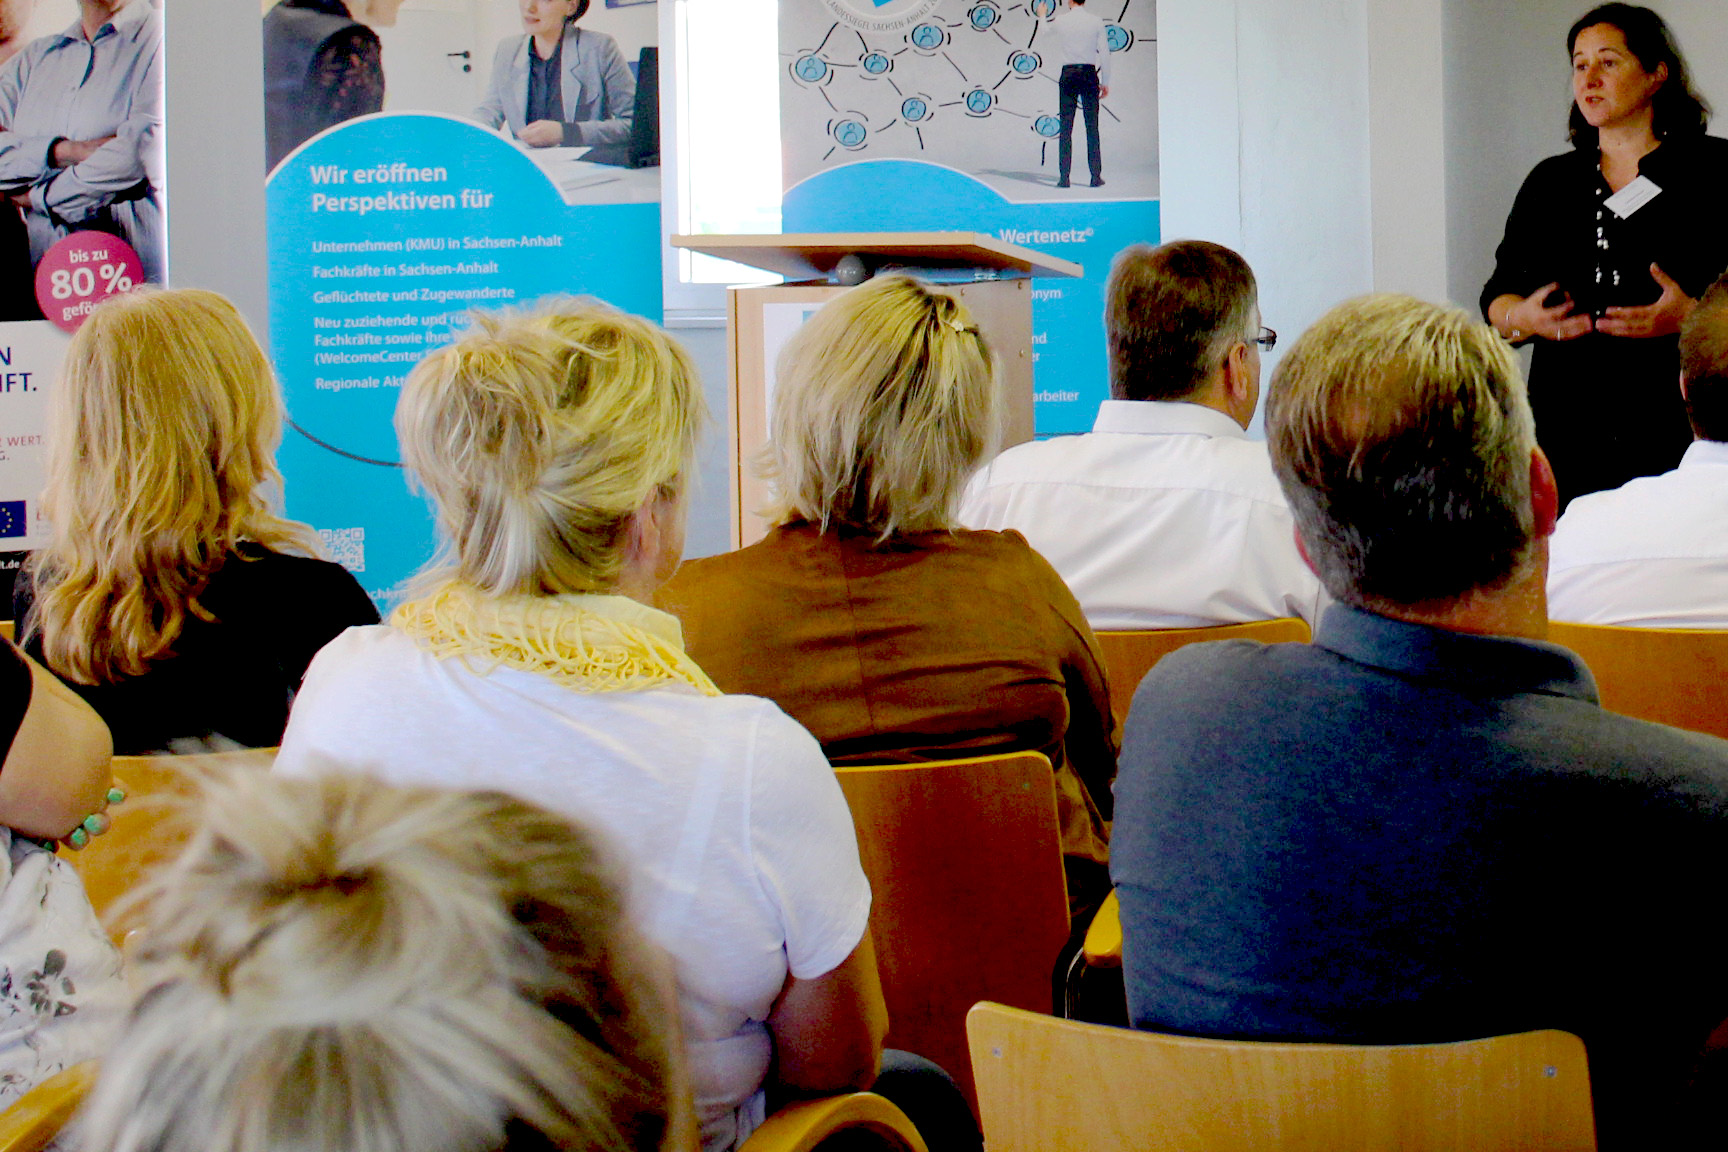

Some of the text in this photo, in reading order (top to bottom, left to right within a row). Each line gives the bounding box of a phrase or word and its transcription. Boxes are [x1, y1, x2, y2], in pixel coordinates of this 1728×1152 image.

[310, 164, 447, 184] Wir eröffnen
[313, 189, 493, 215] Perspektiven für
[312, 234, 562, 253] Unternehmen (KMU) in Sachsen-Anhalt
[69, 249, 108, 264] bis zu
[313, 260, 498, 278] Fachkräfte in Sachsen-Anhalt
[51, 267, 95, 300] 80
[313, 287, 515, 303] Geflüchtete und Zugewanderte
[314, 316, 341, 329] Neu
[343, 314, 418, 328] zuziehende
[421, 313, 447, 326] und
[314, 333, 382, 347] Fachkräfte
[385, 331, 422, 345] sowie
[315, 376, 380, 392] Regionale
